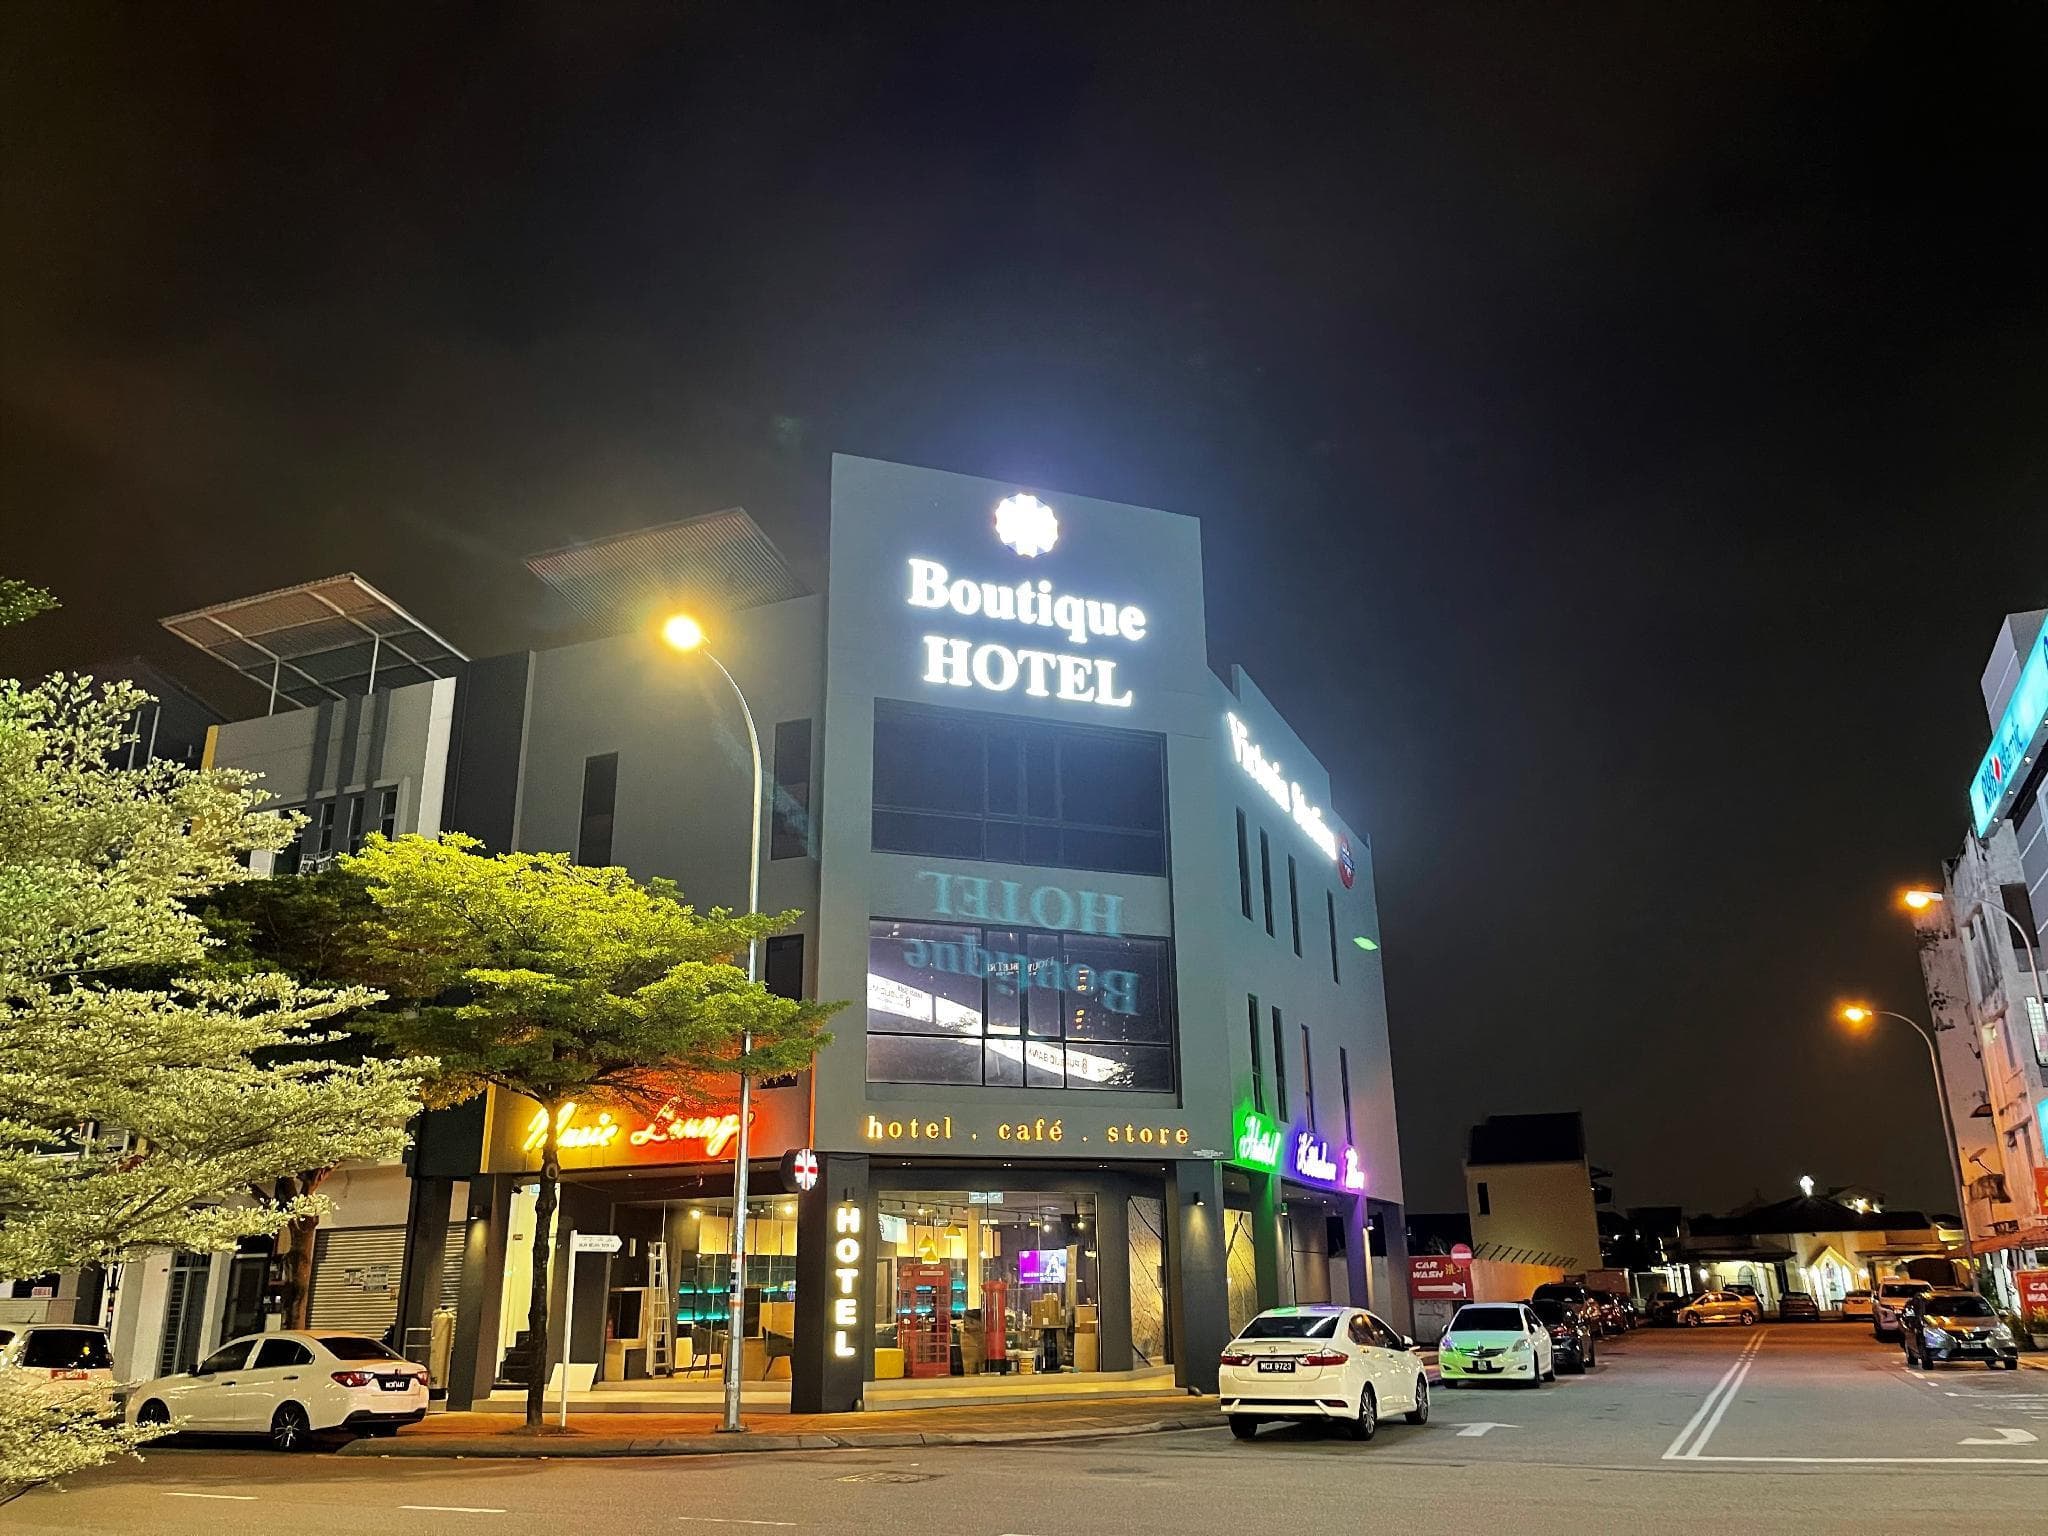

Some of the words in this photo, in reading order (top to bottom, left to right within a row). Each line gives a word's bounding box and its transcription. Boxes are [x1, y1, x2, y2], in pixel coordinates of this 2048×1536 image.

[907, 558, 1147, 643] Boutique
[922, 635, 1134, 708] HOTEL
[866, 1115, 952, 1139] hotel
[998, 1117, 1064, 1143] café
[1107, 1123, 1190, 1145] store
[1412, 1270, 1444, 1279] WASH
[1415, 1261, 1438, 1269] CAR
[834, 1206, 861, 1357] HOTEL
[2029, 1282, 2048, 1292] CA
